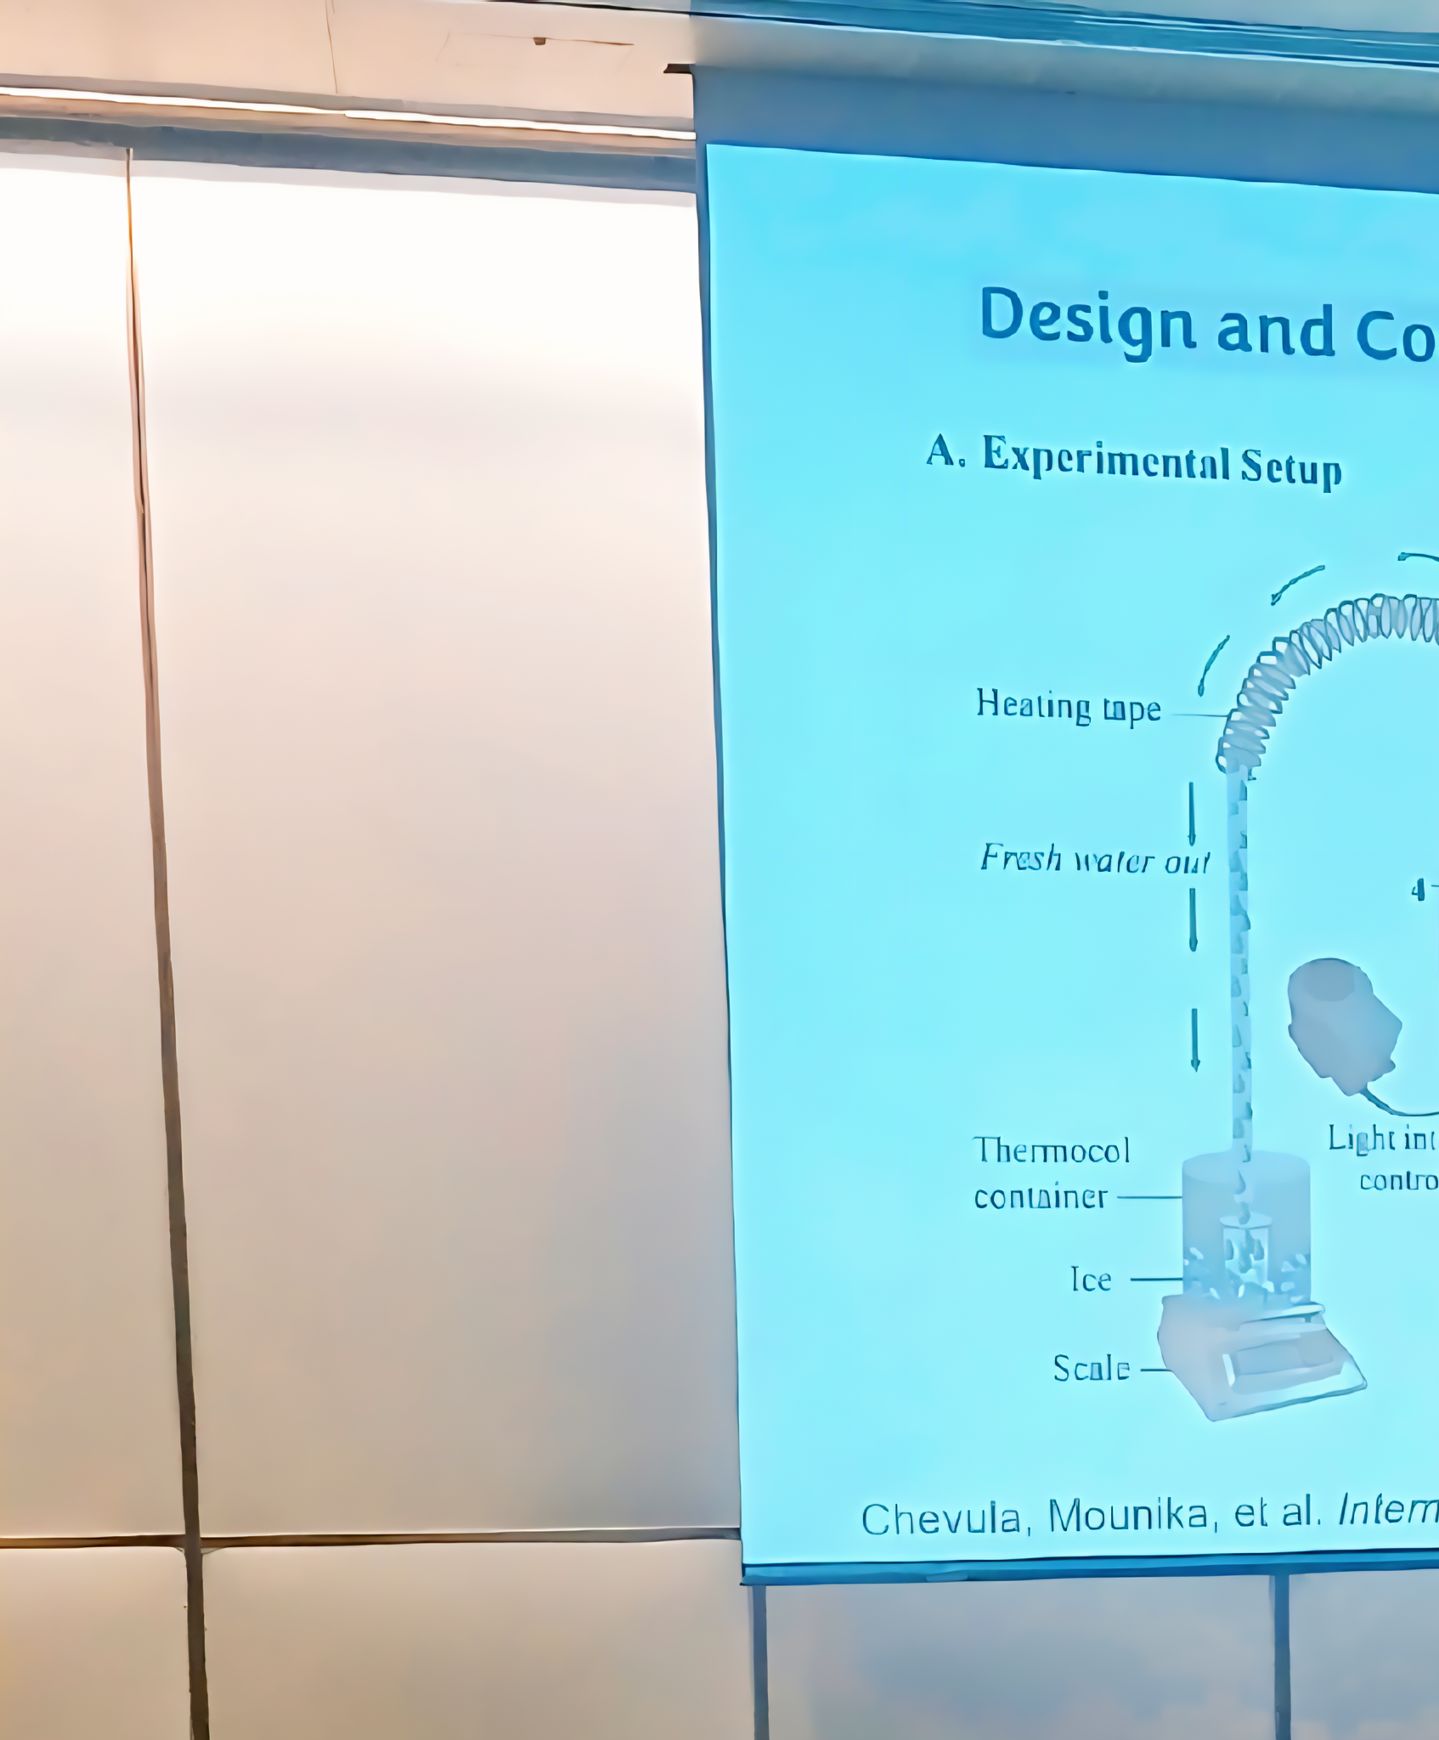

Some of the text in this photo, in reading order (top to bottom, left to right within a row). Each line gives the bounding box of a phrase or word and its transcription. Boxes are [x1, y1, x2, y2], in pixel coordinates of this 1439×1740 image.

[981, 286, 1198, 364] Design
[1217, 303, 1336, 358] and
[925, 432, 1342, 494] A. Experimental Setup
[976, 687, 1162, 730] Heating tape
[980, 842, 1212, 875] Fresh water out
[972, 1135, 1130, 1164] Thermocol
[1328, 1123, 1396, 1158] Light
[974, 1187, 1109, 1210] container
[1070, 1265, 1112, 1293] Ice
[1053, 1353, 1131, 1383] Scale
[862, 1499, 1032, 1537] Chevula,
[1049, 1496, 1218, 1534] Mounika,
[1234, 1496, 1269, 1528] et
[1282, 1492, 1321, 1527] al.
